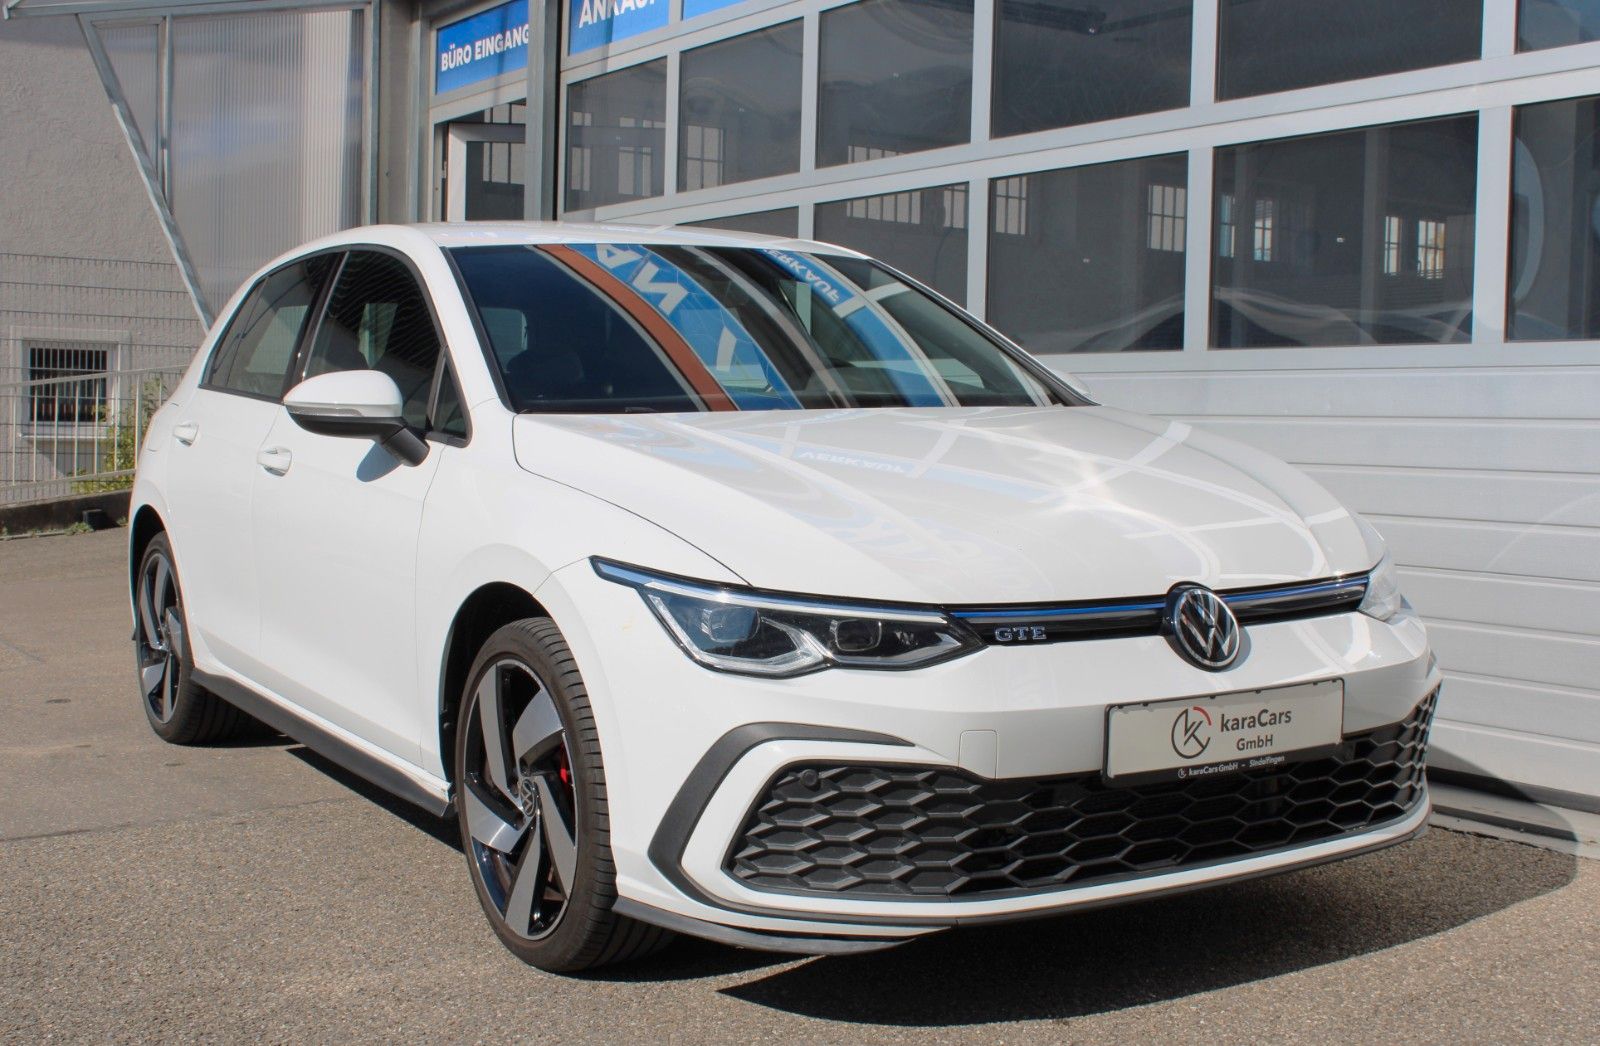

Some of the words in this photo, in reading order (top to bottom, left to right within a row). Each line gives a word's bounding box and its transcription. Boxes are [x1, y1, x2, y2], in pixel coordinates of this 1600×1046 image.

[579, 0, 654, 28] ANK
[441, 43, 472, 72] BÜRO
[995, 626, 1047, 641] GTE
[1220, 708, 1292, 733] karaCars
[1236, 734, 1274, 751] GmbH
[1188, 765, 1218, 777] karaCars
[1218, 762, 1239, 773] GmbH
